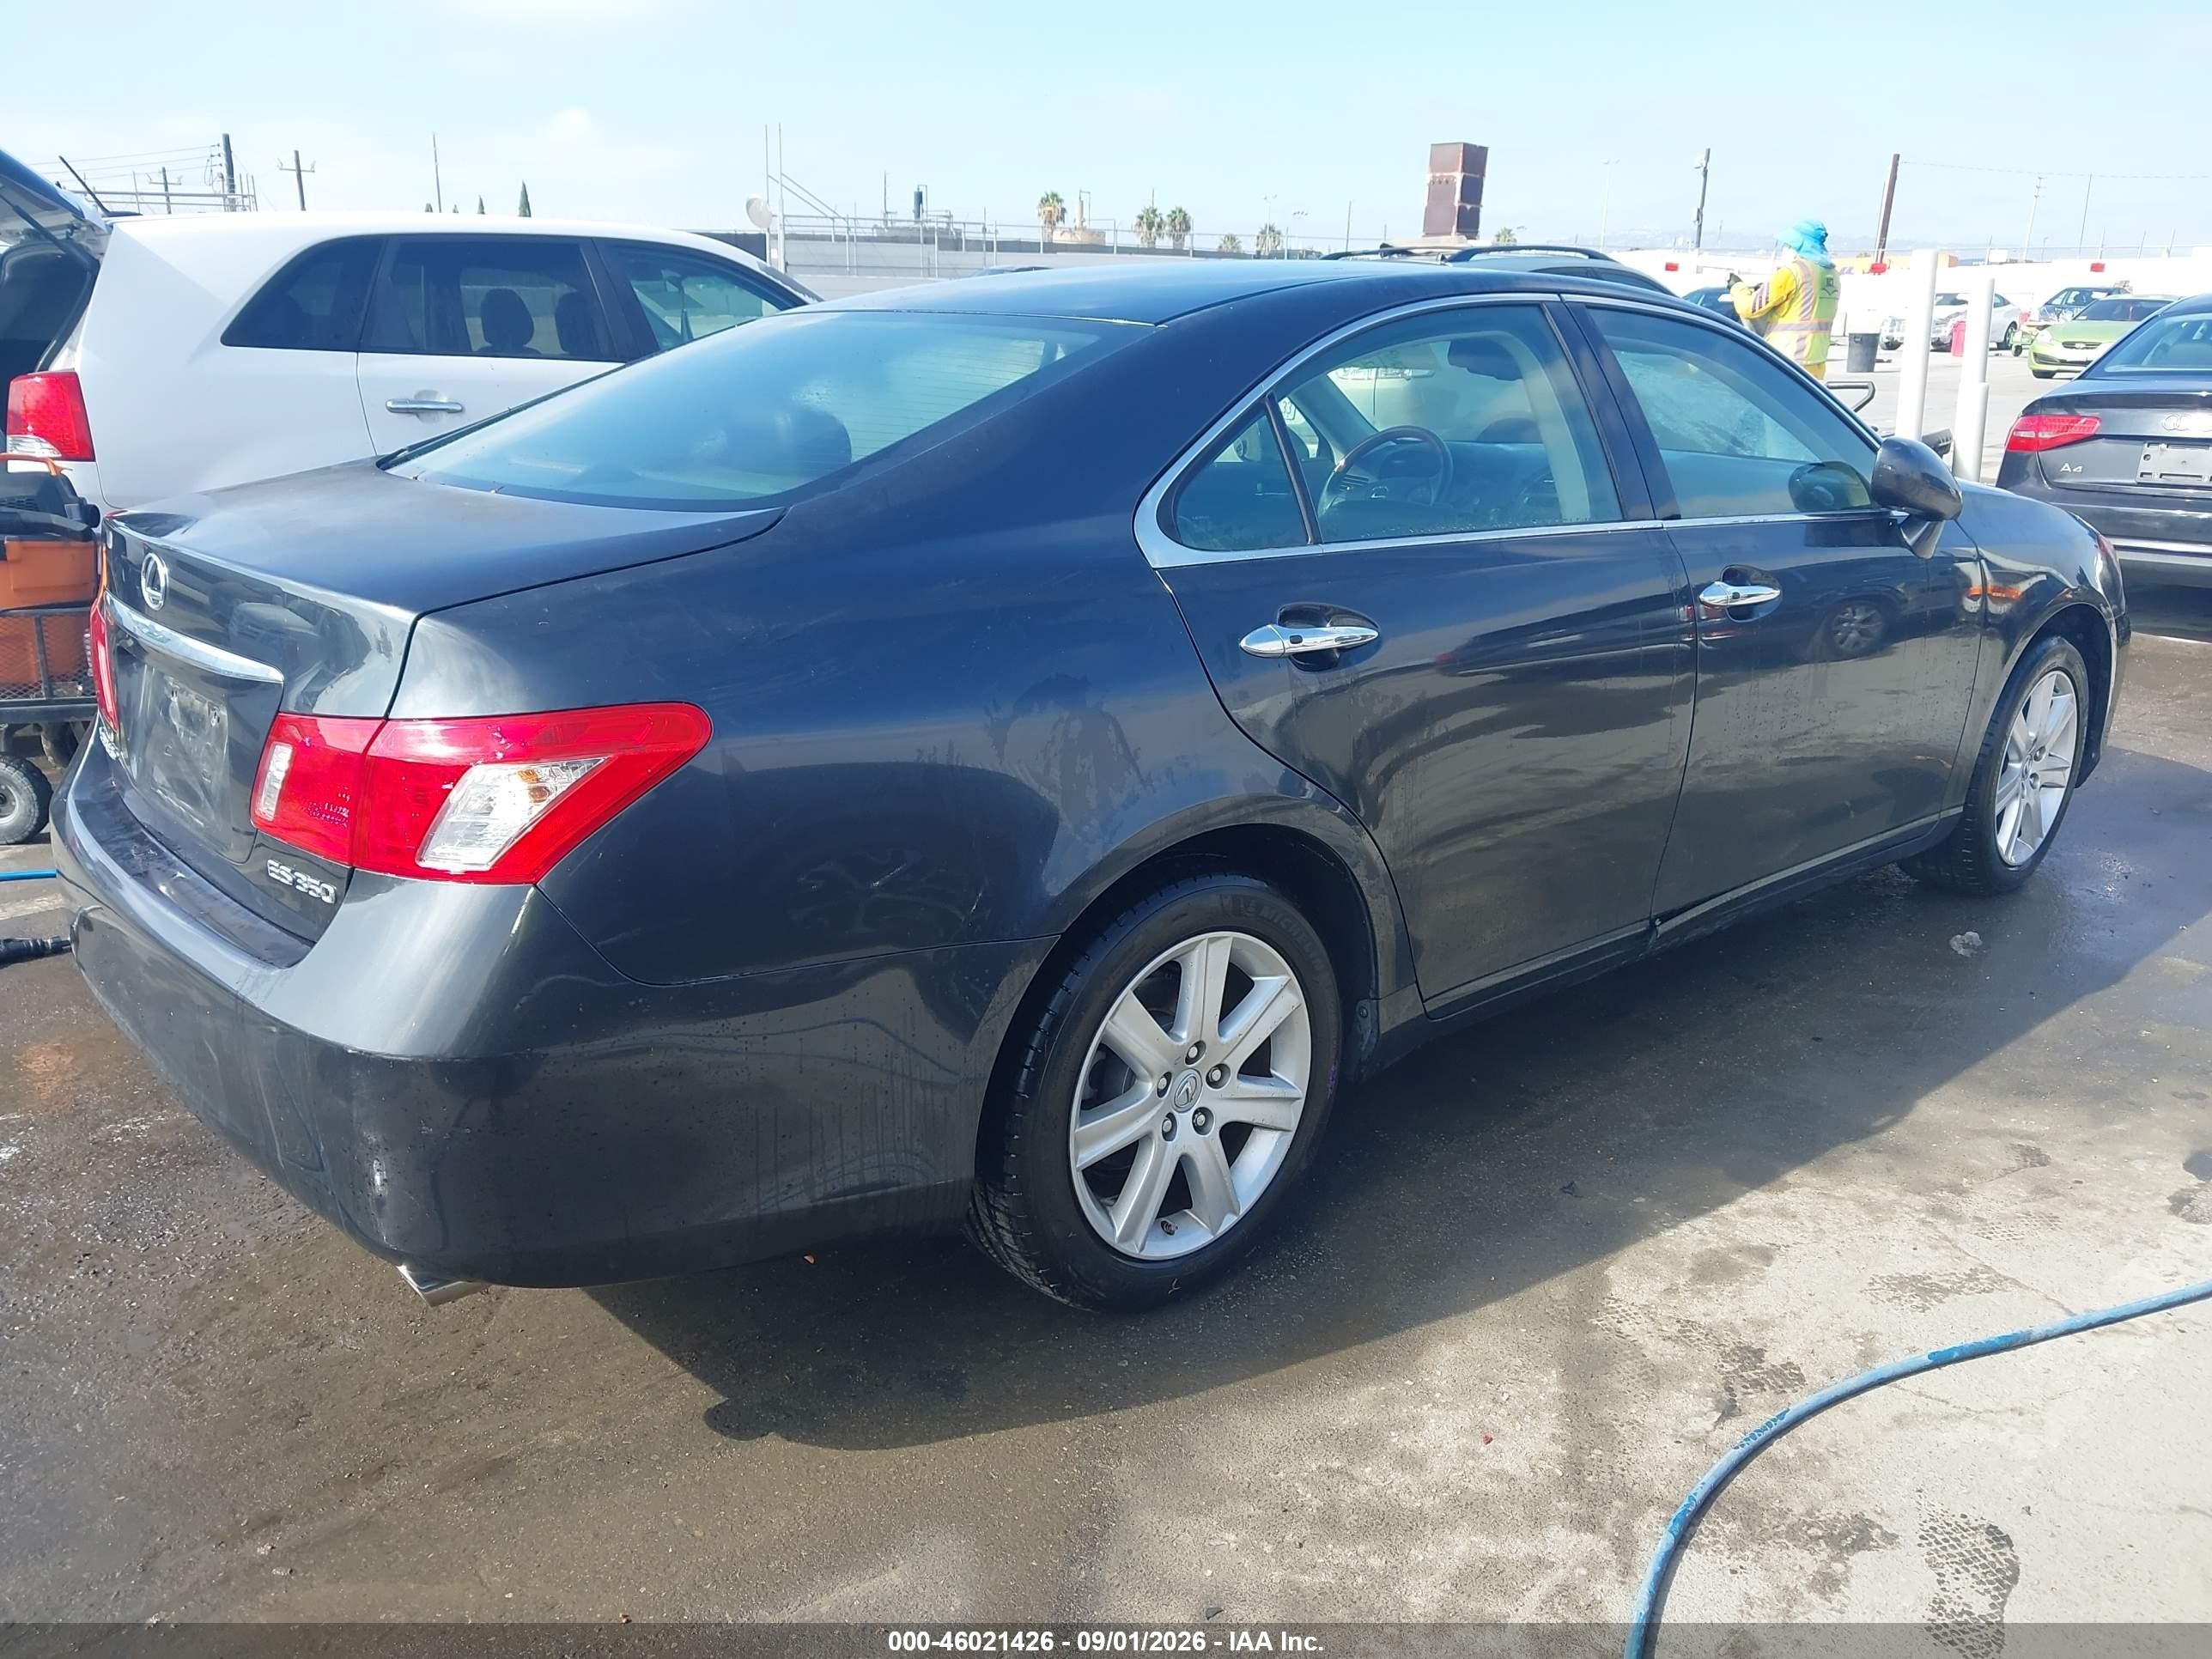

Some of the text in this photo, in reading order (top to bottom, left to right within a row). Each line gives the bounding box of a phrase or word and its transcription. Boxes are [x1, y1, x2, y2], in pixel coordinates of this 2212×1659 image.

[2061, 463, 2082, 472] A4
[267, 860, 337, 904] ES 350
